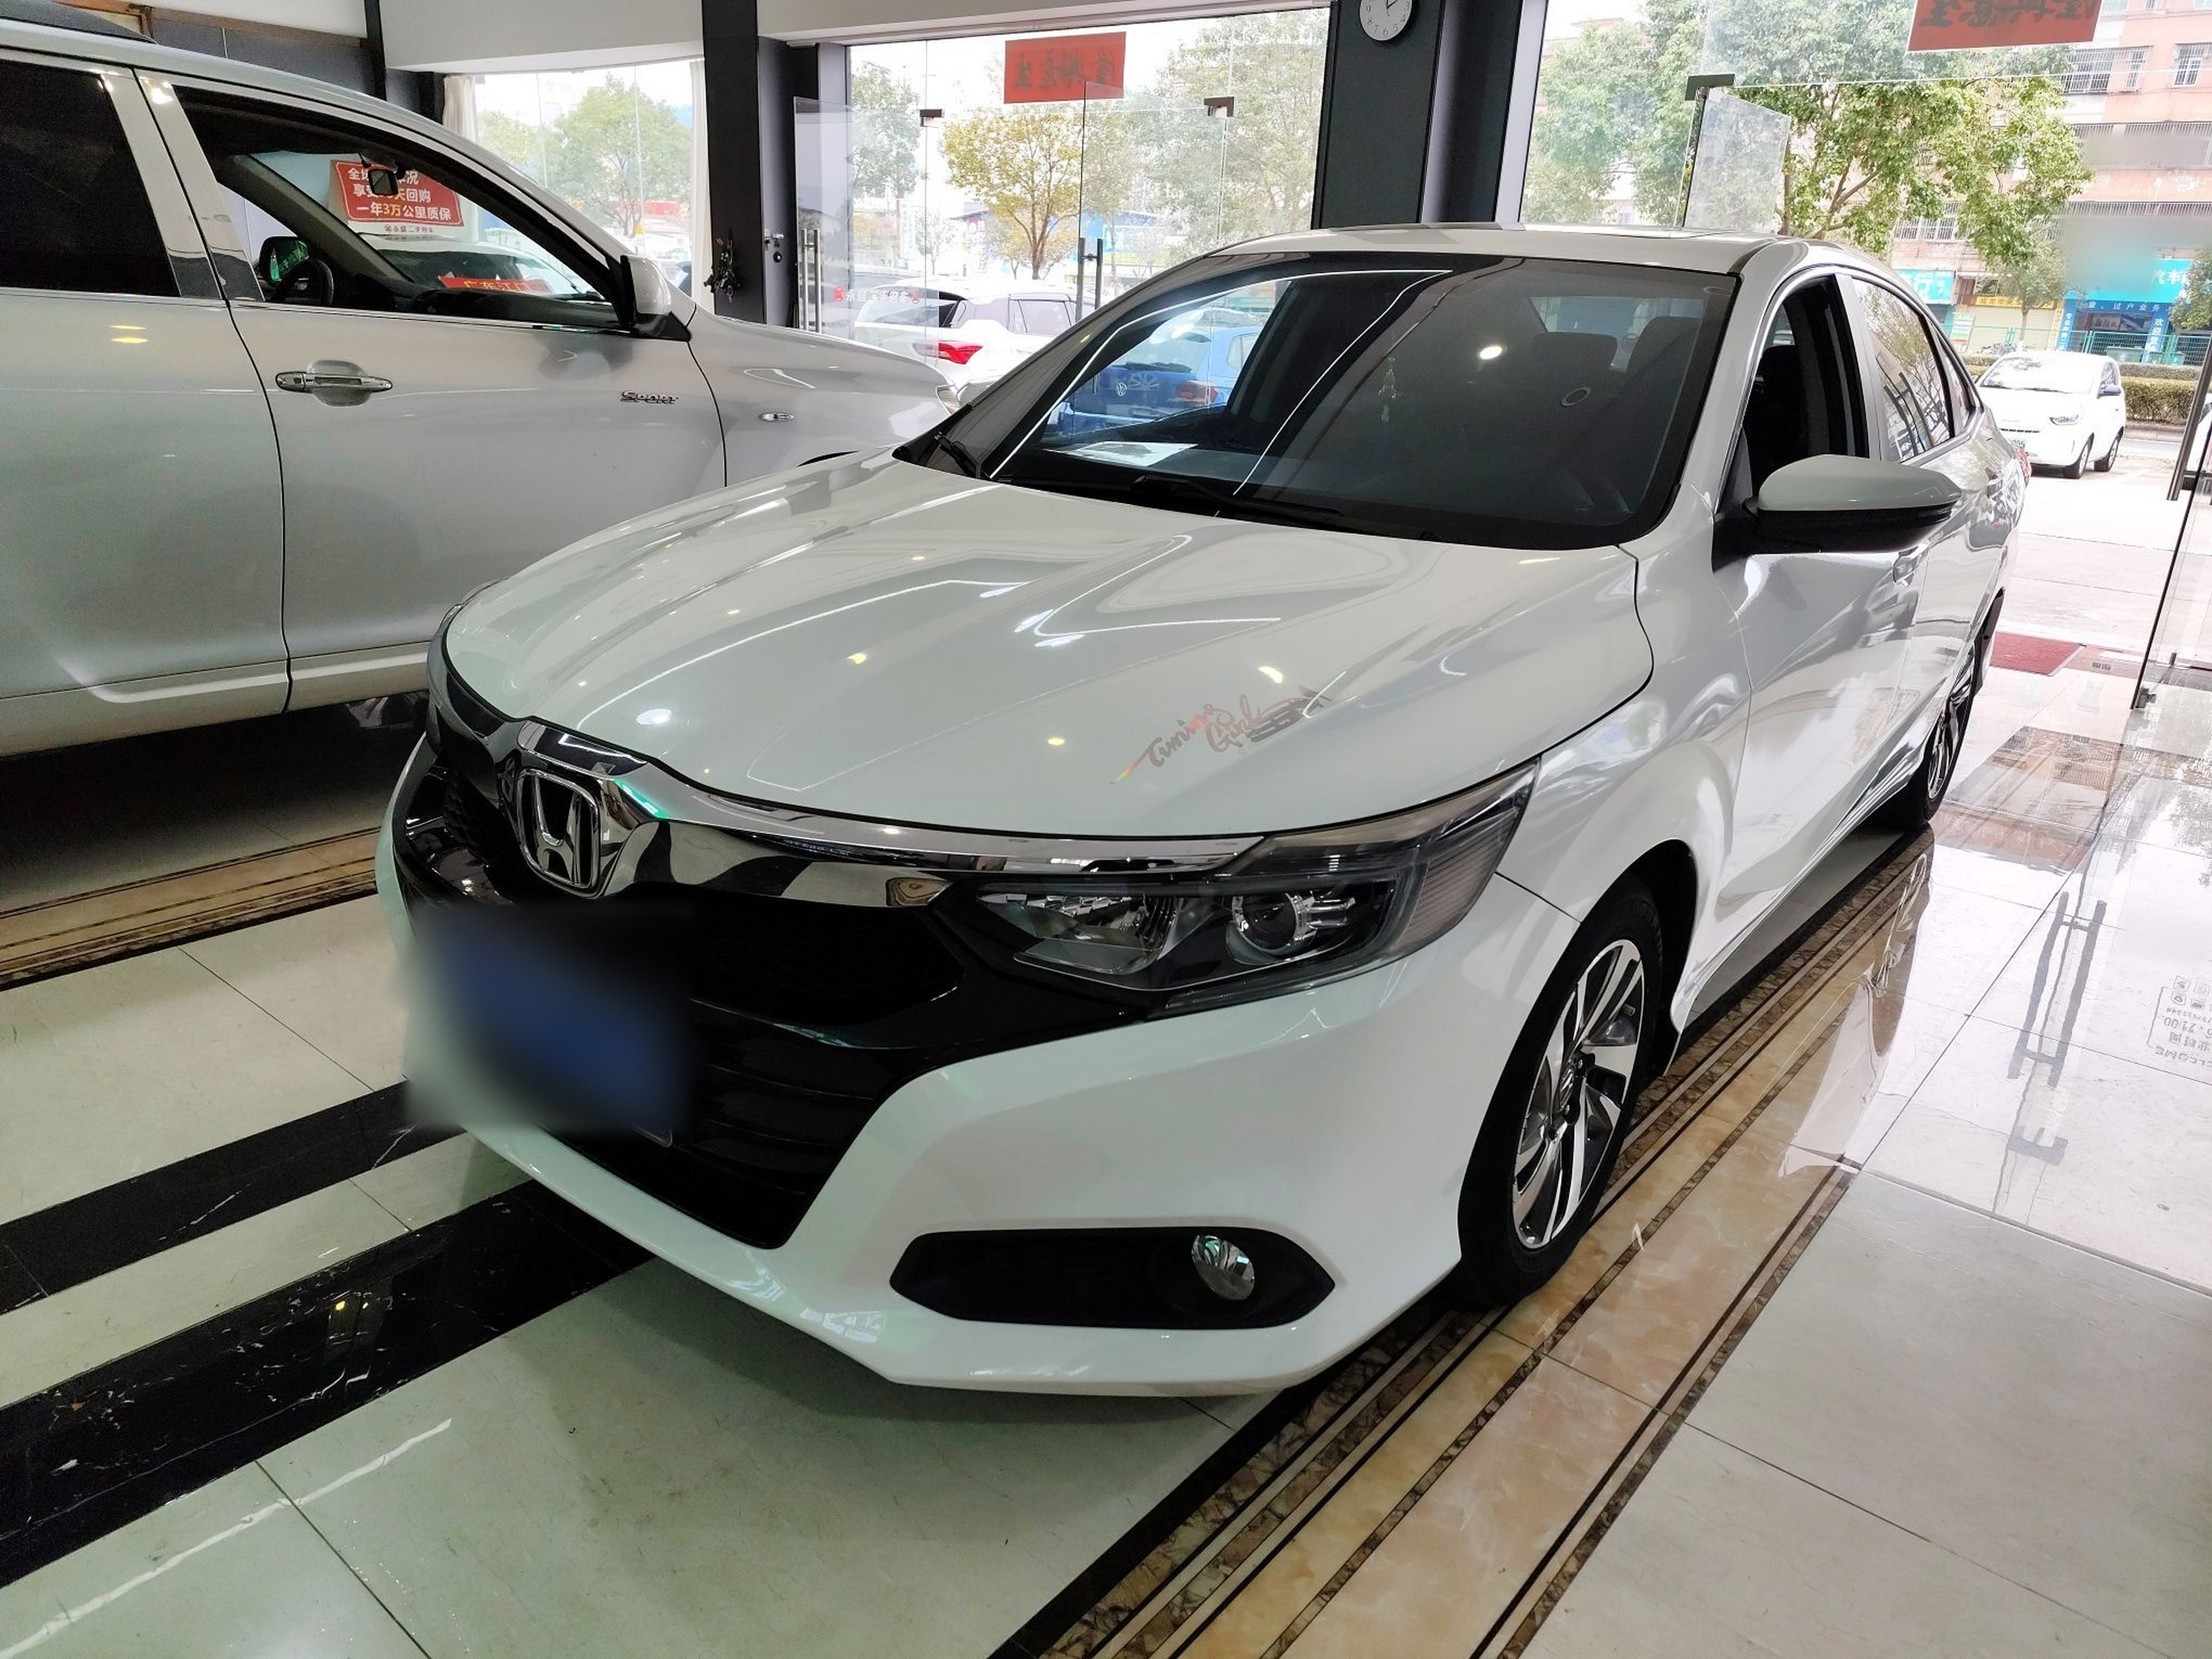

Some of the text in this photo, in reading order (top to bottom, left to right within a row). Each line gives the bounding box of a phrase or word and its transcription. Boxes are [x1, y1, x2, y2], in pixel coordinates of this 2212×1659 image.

[357, 201, 452, 220] 一年3万公里质保
